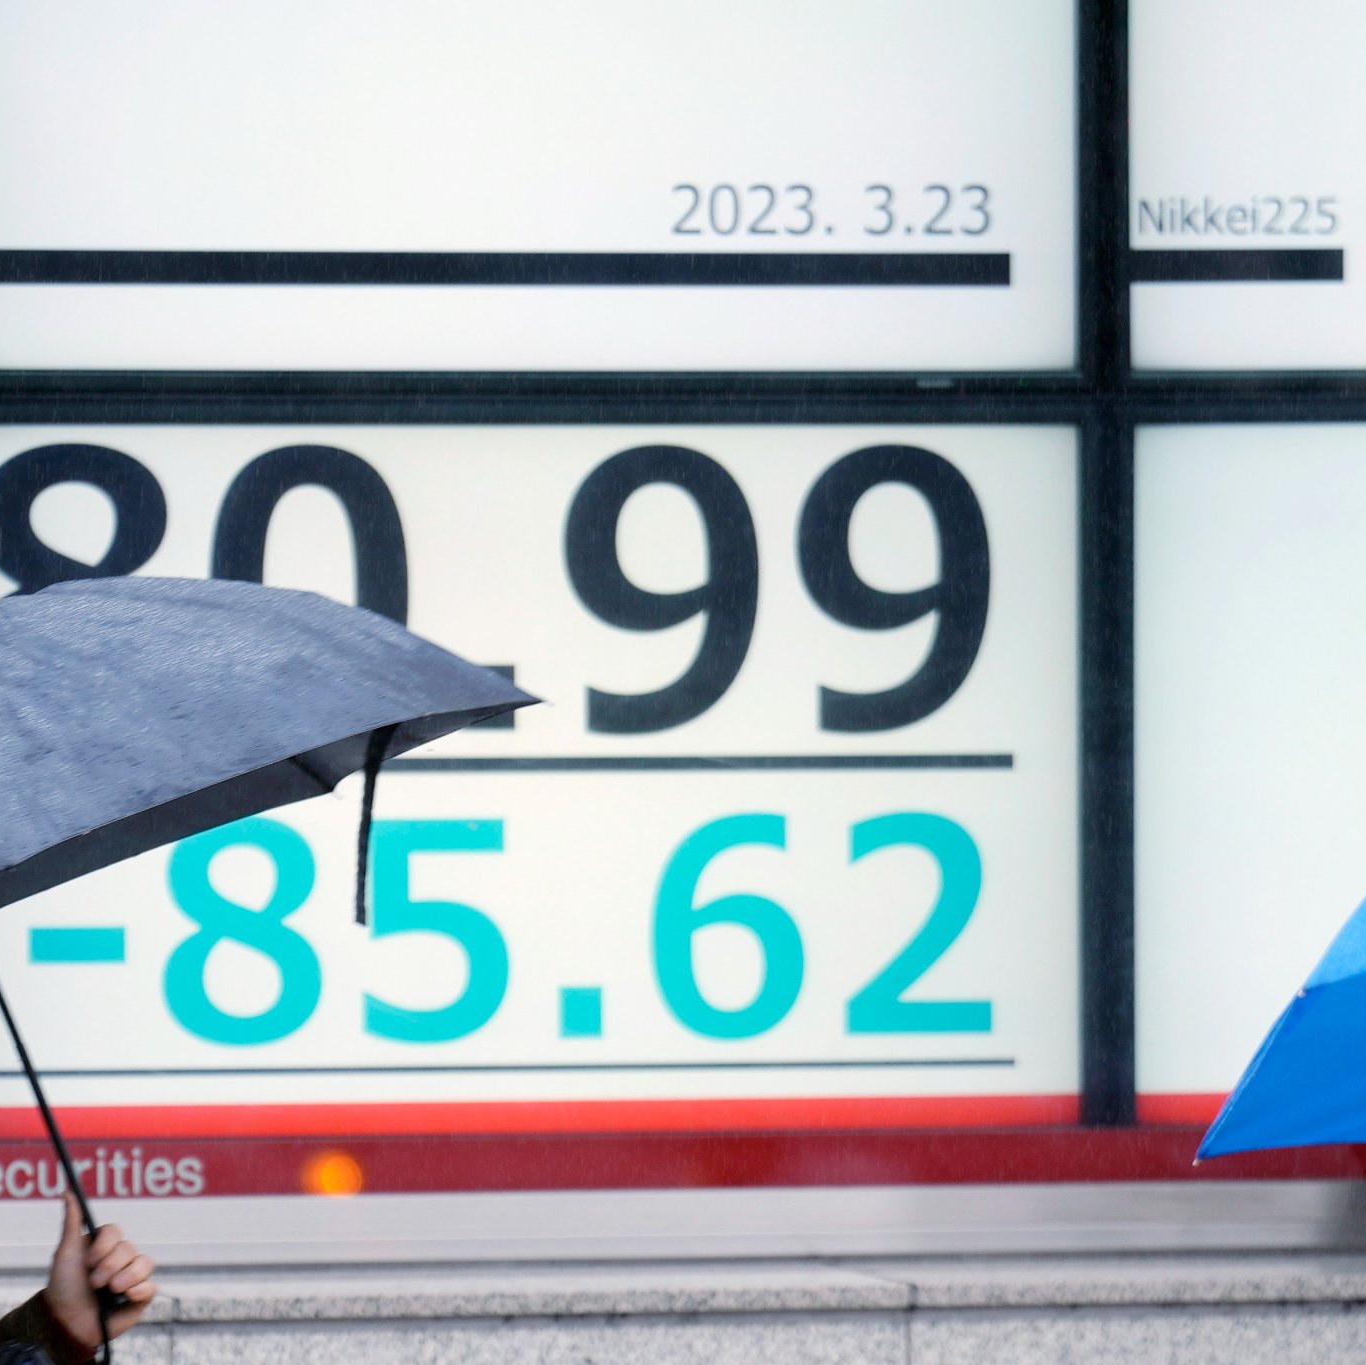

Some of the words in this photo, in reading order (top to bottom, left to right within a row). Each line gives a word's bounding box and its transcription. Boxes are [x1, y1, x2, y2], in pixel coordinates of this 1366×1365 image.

[672, 184, 834, 237] 2023.
[863, 184, 992, 237] 3.23
[1136, 196, 1338, 237] Nikkei225
[28, 811, 994, 1047] -85.62
